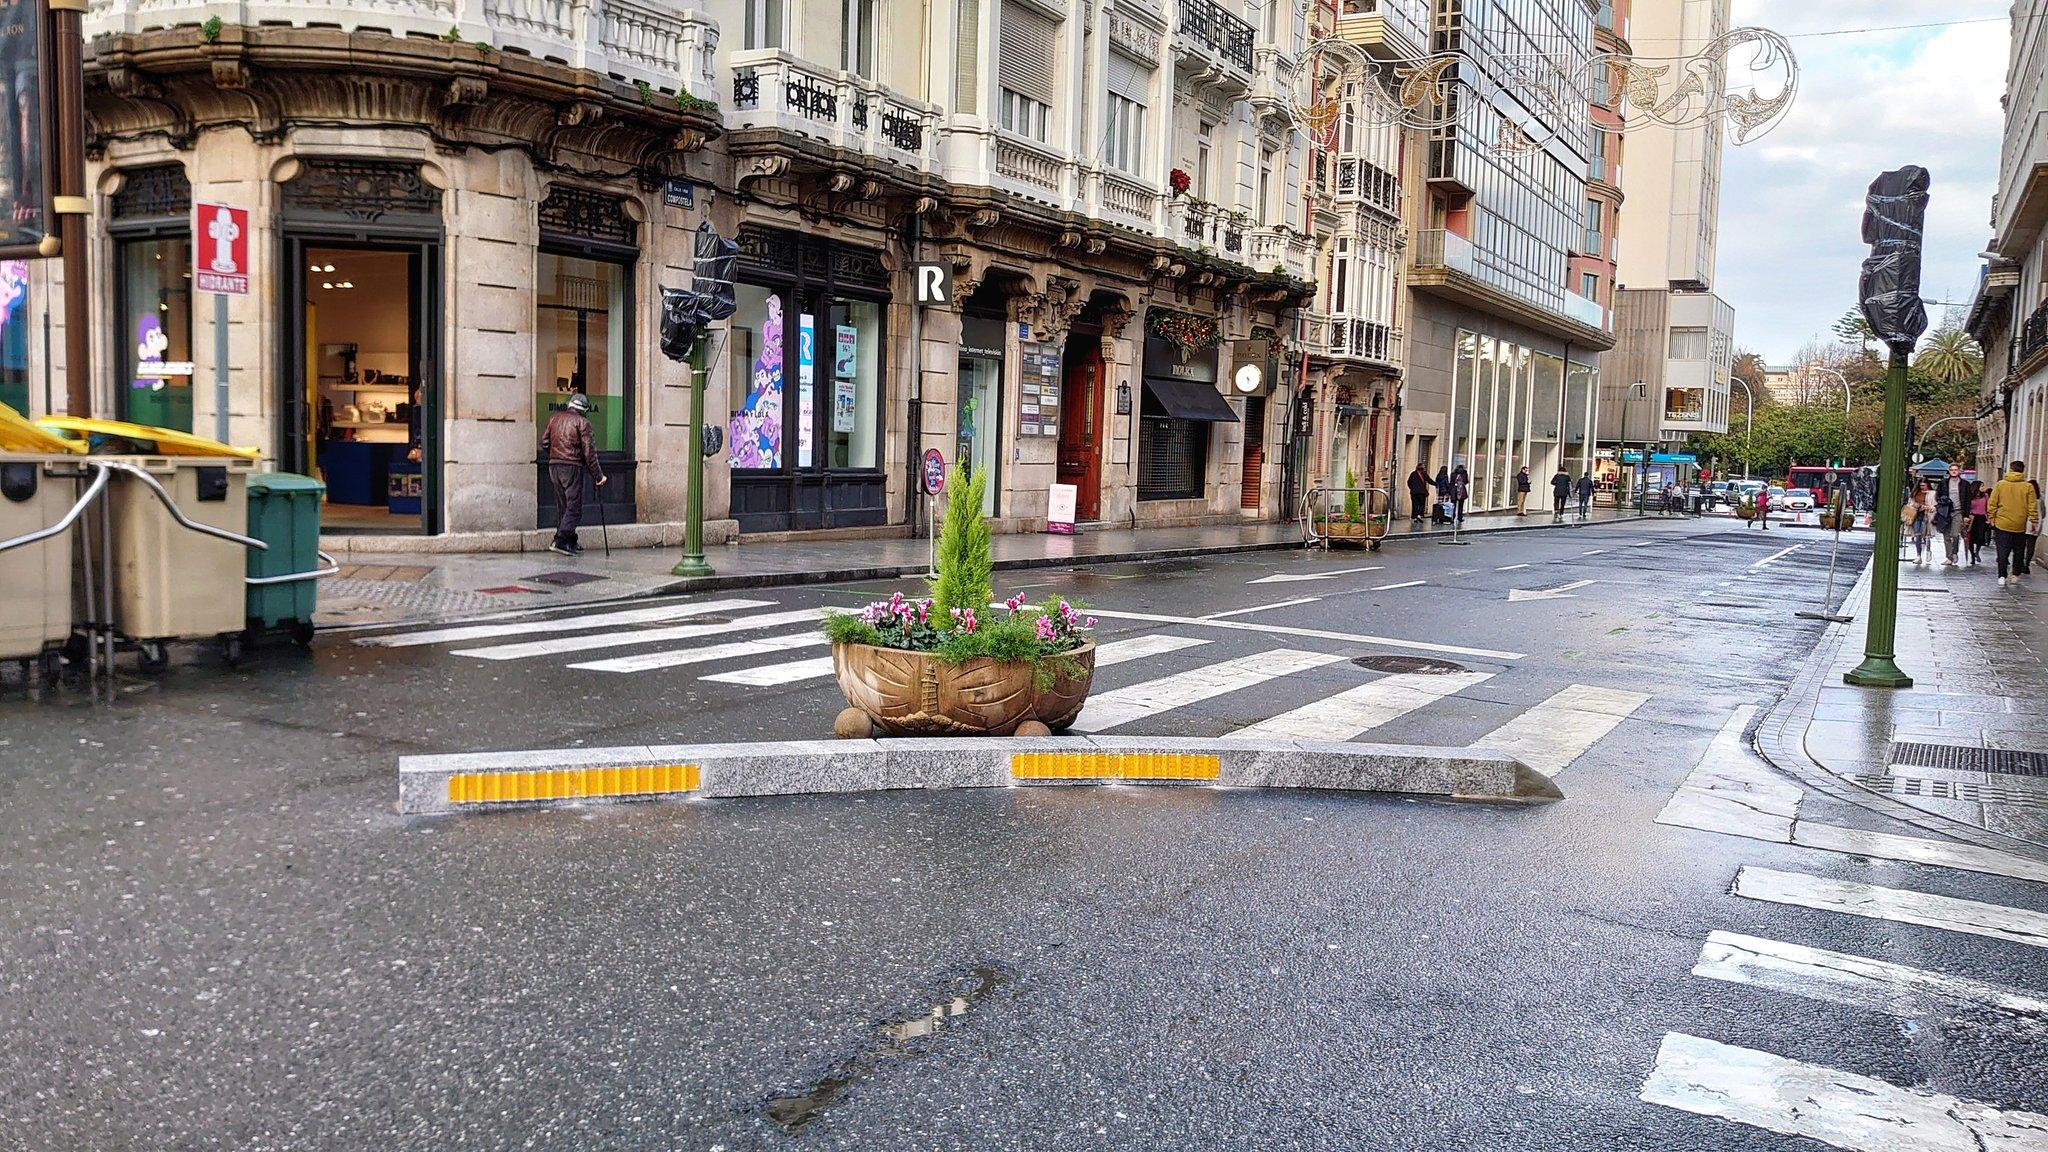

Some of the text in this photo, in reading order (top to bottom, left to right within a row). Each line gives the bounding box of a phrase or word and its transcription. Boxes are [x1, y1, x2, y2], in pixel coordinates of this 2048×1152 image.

[667, 194, 692, 207] COMPOSTELA
[198, 273, 248, 294] HIDRANTE
[918, 265, 946, 302] R
[1172, 364, 1195, 378] ROLEX
[1666, 411, 1700, 419] TEZENIS
